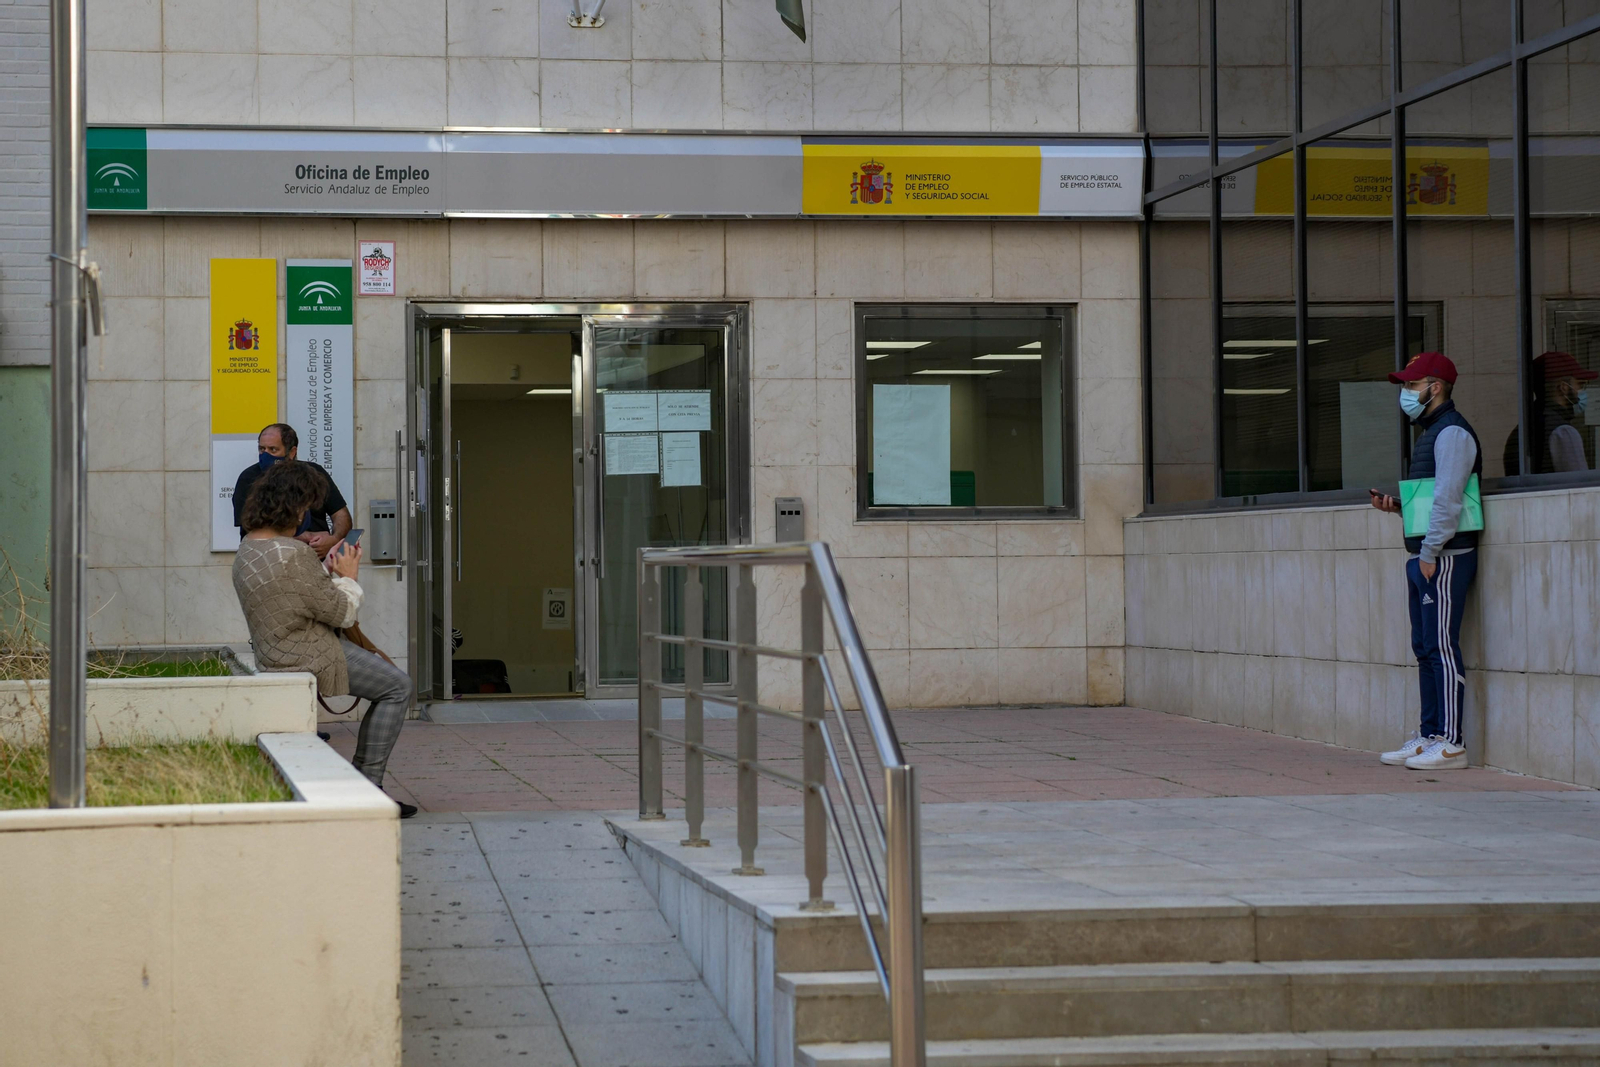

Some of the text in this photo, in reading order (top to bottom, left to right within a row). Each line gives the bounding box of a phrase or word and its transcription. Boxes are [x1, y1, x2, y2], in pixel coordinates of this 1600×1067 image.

[295, 165, 430, 184] Oficina de Empleo
[1090, 173, 1119, 181] PÚBLICO
[284, 184, 430, 197] Servicio Andaluz de Empleo
[905, 183, 950, 191] DE EMPLEO
[904, 192, 990, 200] Y SEGURIDAD SOCIAL
[364, 258, 390, 267] RODYCH
[323, 338, 333, 385] COMERCIO
[307, 338, 320, 463] Servicio Andaluz de Empleo
[323, 392, 333, 431] EMPRESA
[323, 433, 334, 470] EMPLEO,
